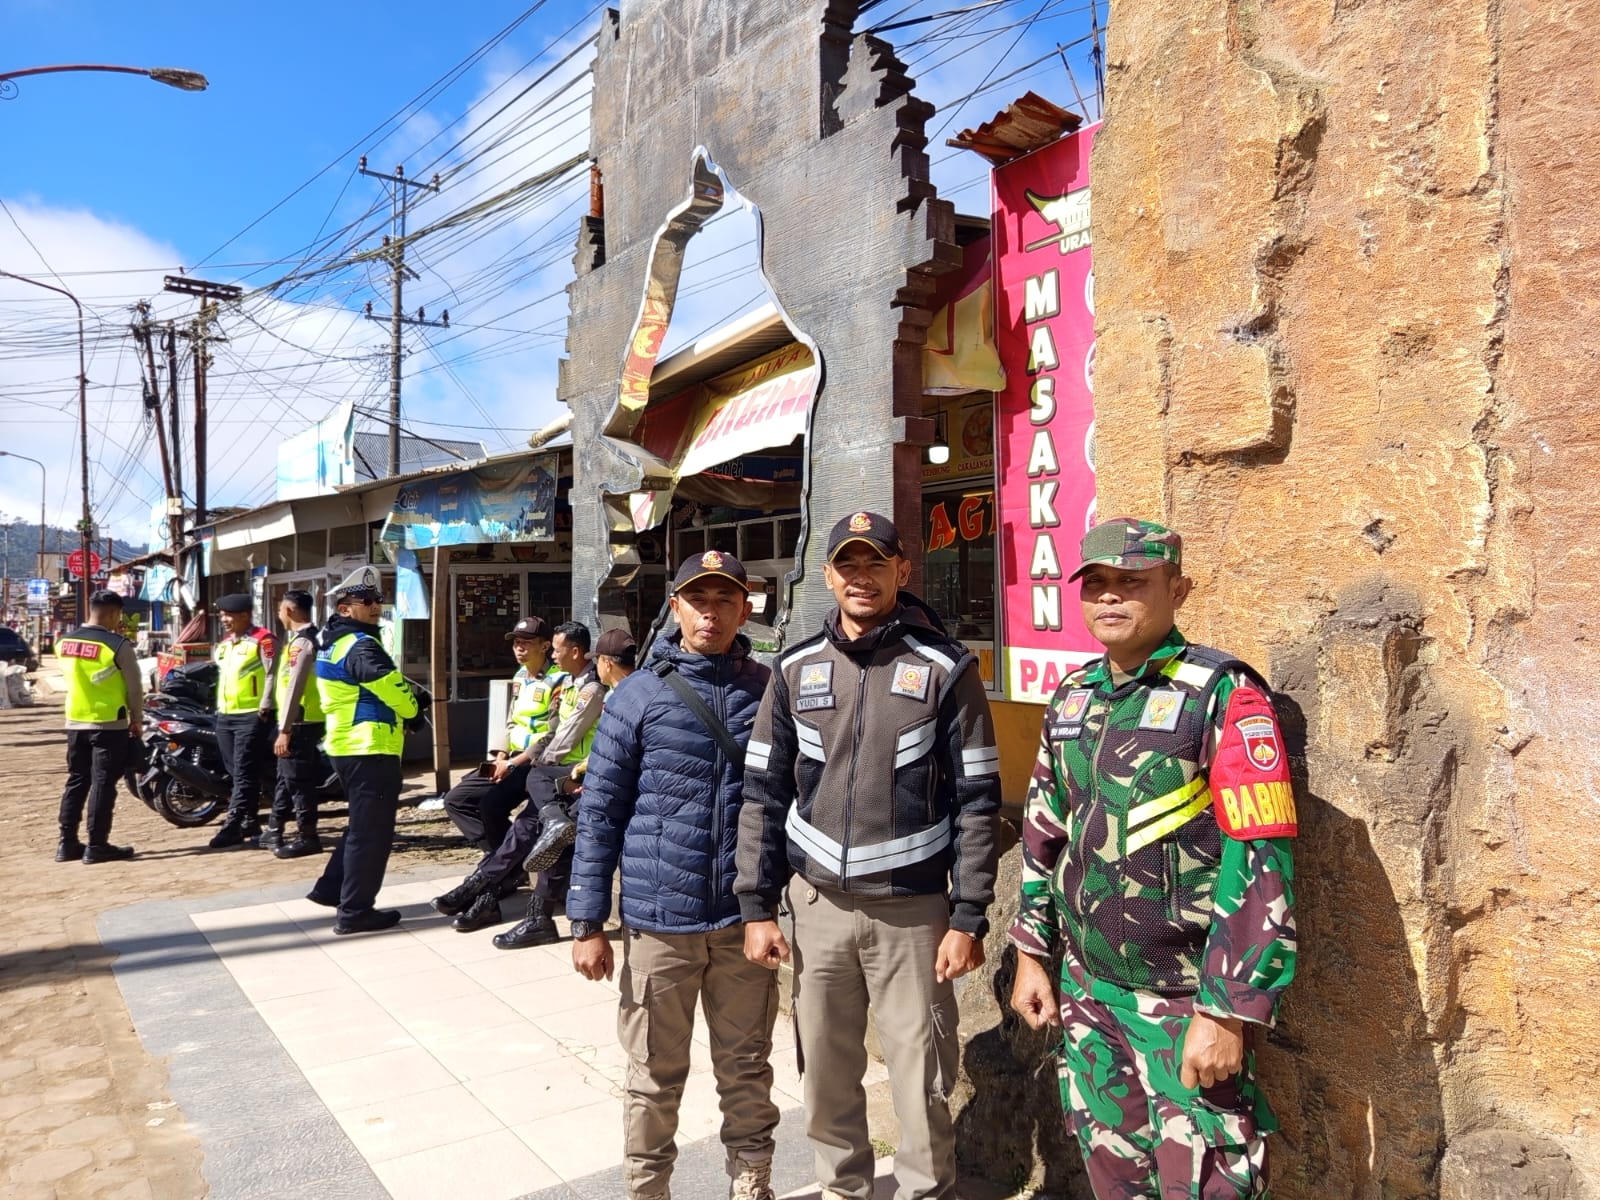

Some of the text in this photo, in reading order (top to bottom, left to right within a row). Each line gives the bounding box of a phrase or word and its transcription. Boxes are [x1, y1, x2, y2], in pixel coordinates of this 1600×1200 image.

[1059, 230, 1093, 255] URA
[1025, 270, 1060, 630] MASAKAN
[62, 642, 98, 658] POLISI
[1020, 659, 1083, 695] PA
[799, 698, 818, 708] YUDI
